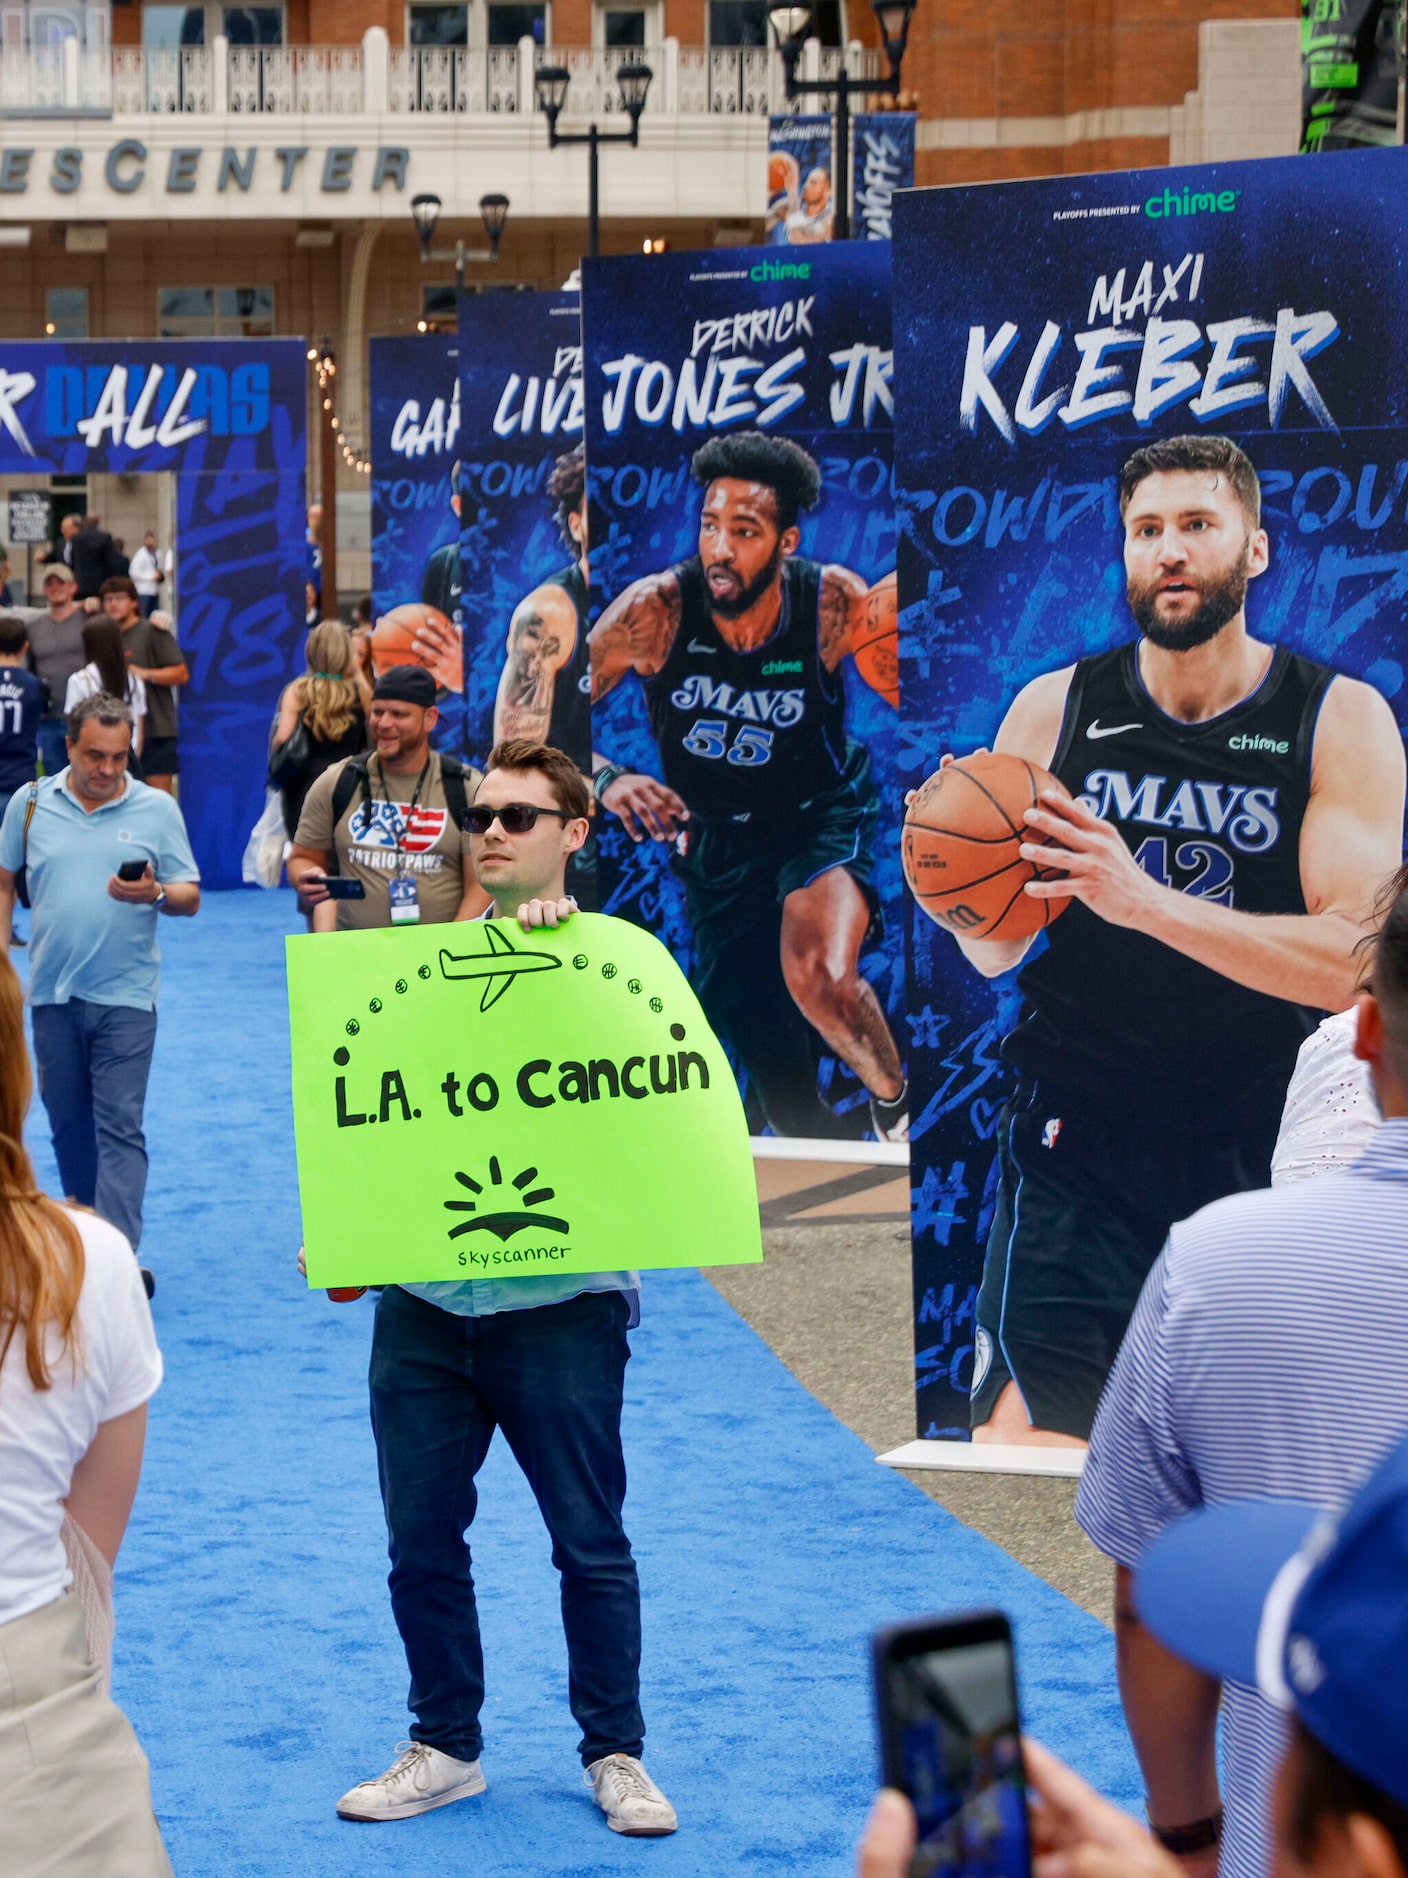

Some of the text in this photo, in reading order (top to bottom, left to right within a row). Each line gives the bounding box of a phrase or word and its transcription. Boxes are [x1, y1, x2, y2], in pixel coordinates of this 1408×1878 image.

[1053, 203, 1141, 222] PLAYOFFS PRESENTED BY
[1144, 186, 1238, 219] chime
[750, 258, 812, 283] chime
[1087, 252, 1205, 327] MAXI
[689, 295, 817, 360] DERRICK
[76, 362, 210, 451] ALL
[600, 346, 808, 437] JONES
[958, 306, 1343, 448] KLEBER
[761, 660, 804, 676] chime
[670, 674, 806, 729] MAVS
[682, 718, 775, 767] 55
[1228, 733, 1290, 754] chime
[1074, 768, 1281, 855] MAVS
[1133, 836, 1235, 909] 42
[441, 1071, 500, 1117] to
[516, 1050, 711, 1108] Cancun
[458, 1246, 573, 1270] skyscanner
